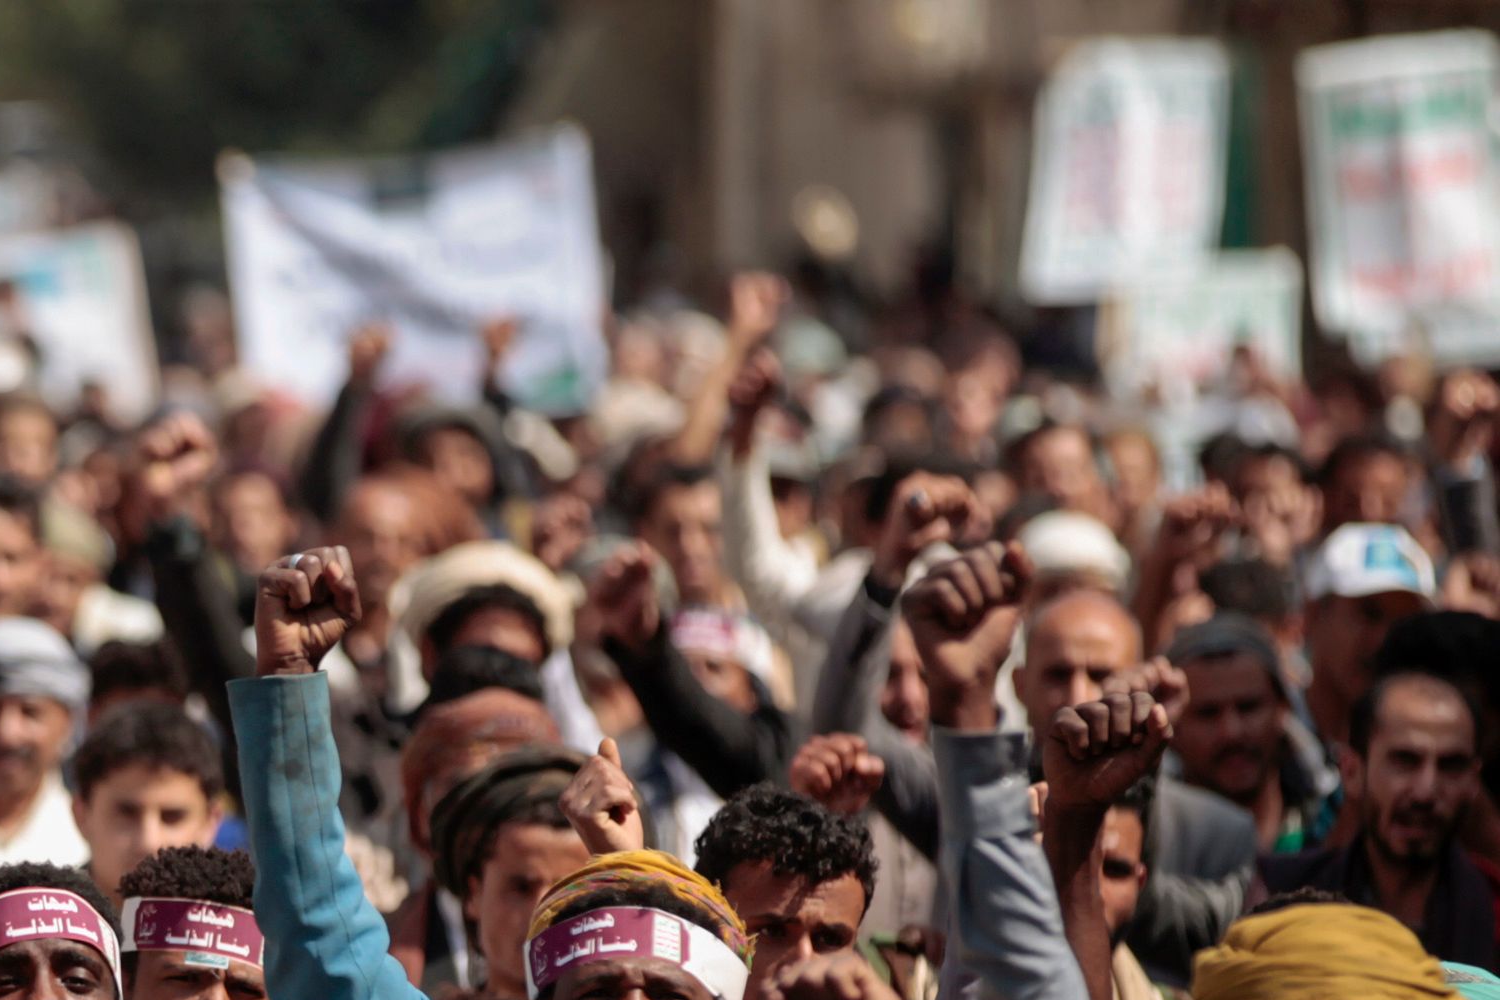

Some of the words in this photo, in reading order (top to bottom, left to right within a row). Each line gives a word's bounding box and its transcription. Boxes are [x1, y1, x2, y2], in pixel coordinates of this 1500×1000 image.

[27, 894, 78, 914] هيهات
[5, 917, 63, 937] الذلة
[186, 905, 235, 929] هيهات
[570, 912, 615, 935] هيهات
[66, 917, 99, 943] منا
[164, 928, 214, 948] الذلة
[215, 933, 251, 957] منا
[554, 937, 596, 967] الذلة
[597, 935, 638, 953] منا
